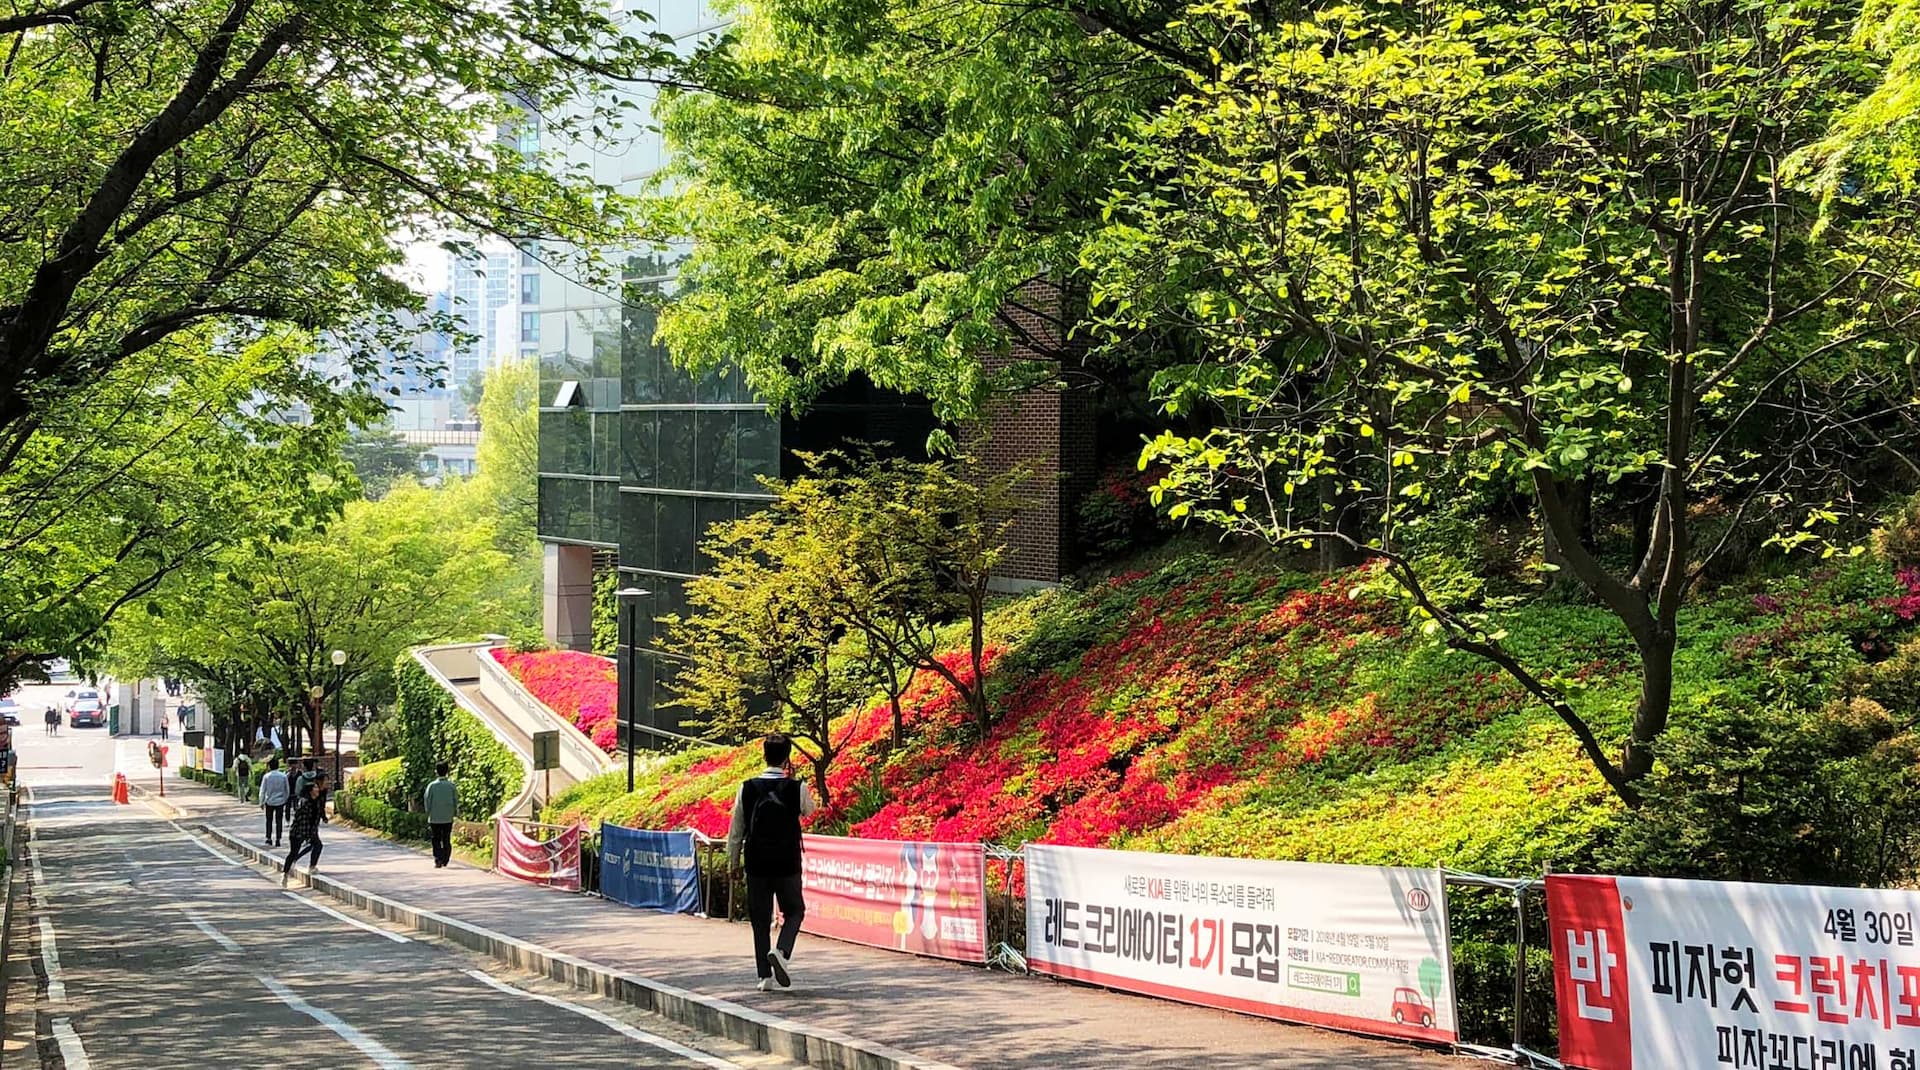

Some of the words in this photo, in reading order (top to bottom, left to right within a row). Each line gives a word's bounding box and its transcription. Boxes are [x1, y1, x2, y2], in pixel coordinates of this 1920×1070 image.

[1124, 875, 1146, 897] 새로운
[1148, 878, 1172, 900] KIA를
[1173, 880, 1190, 902] 위한
[1192, 881, 1208, 904] 너의
[1210, 883, 1245, 908] 목소리를
[1247, 886, 1275, 911] 들려줘
[1824, 909, 1857, 942] 4월
[1864, 911, 1913, 947] 30일
[1045, 898, 1080, 949] 레드
[1084, 904, 1184, 969] 크리에이터
[1189, 917, 1224, 975] 1기
[1230, 922, 1280, 984] 모집
[1565, 928, 1618, 1023] 반
[1649, 940, 1761, 1014] 피자헛
